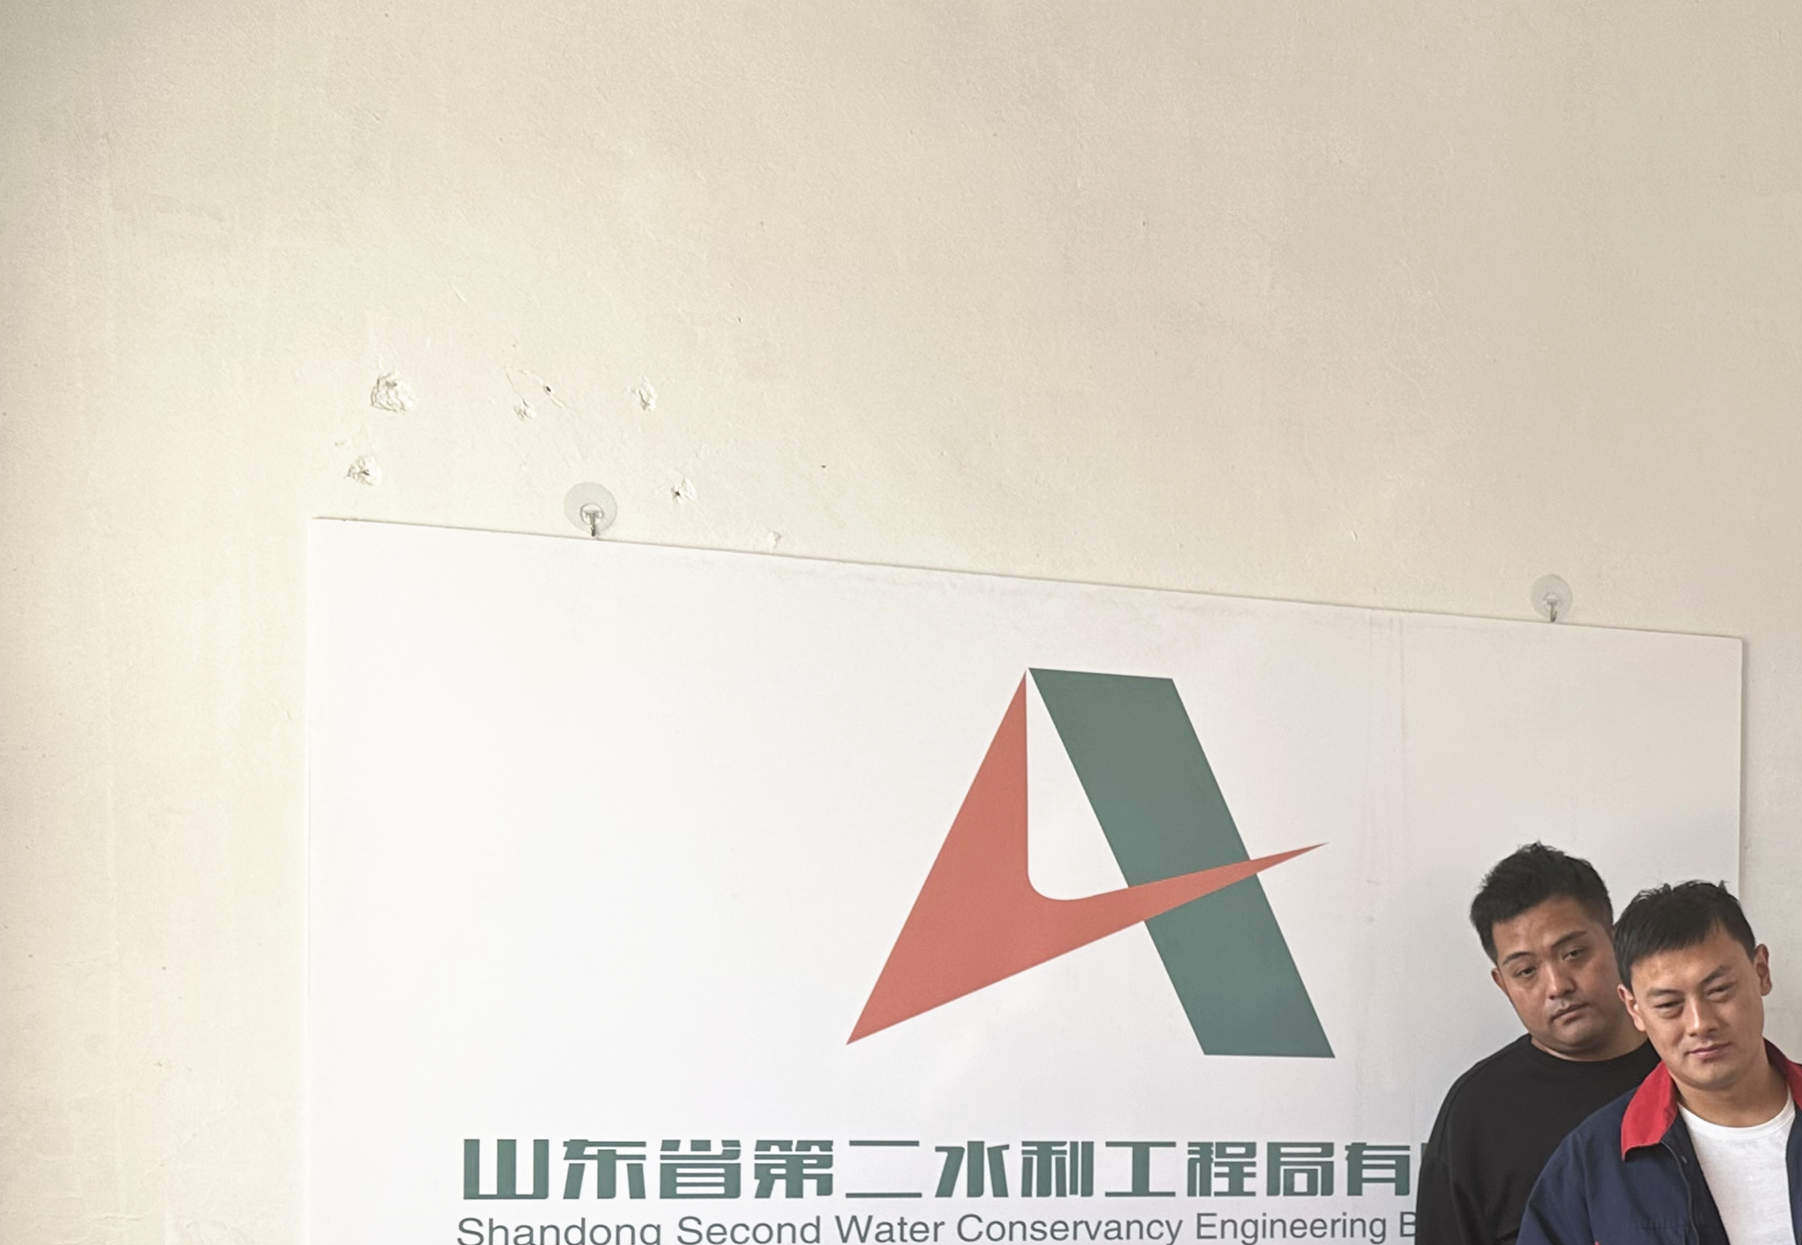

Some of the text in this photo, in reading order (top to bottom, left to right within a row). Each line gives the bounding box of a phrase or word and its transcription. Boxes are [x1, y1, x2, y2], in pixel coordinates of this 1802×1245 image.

[463, 1139, 1427, 1201] 山东省第二水利工程局有
[834, 1214, 946, 1244] Water
[1195, 1210, 1388, 1245] Engineering
